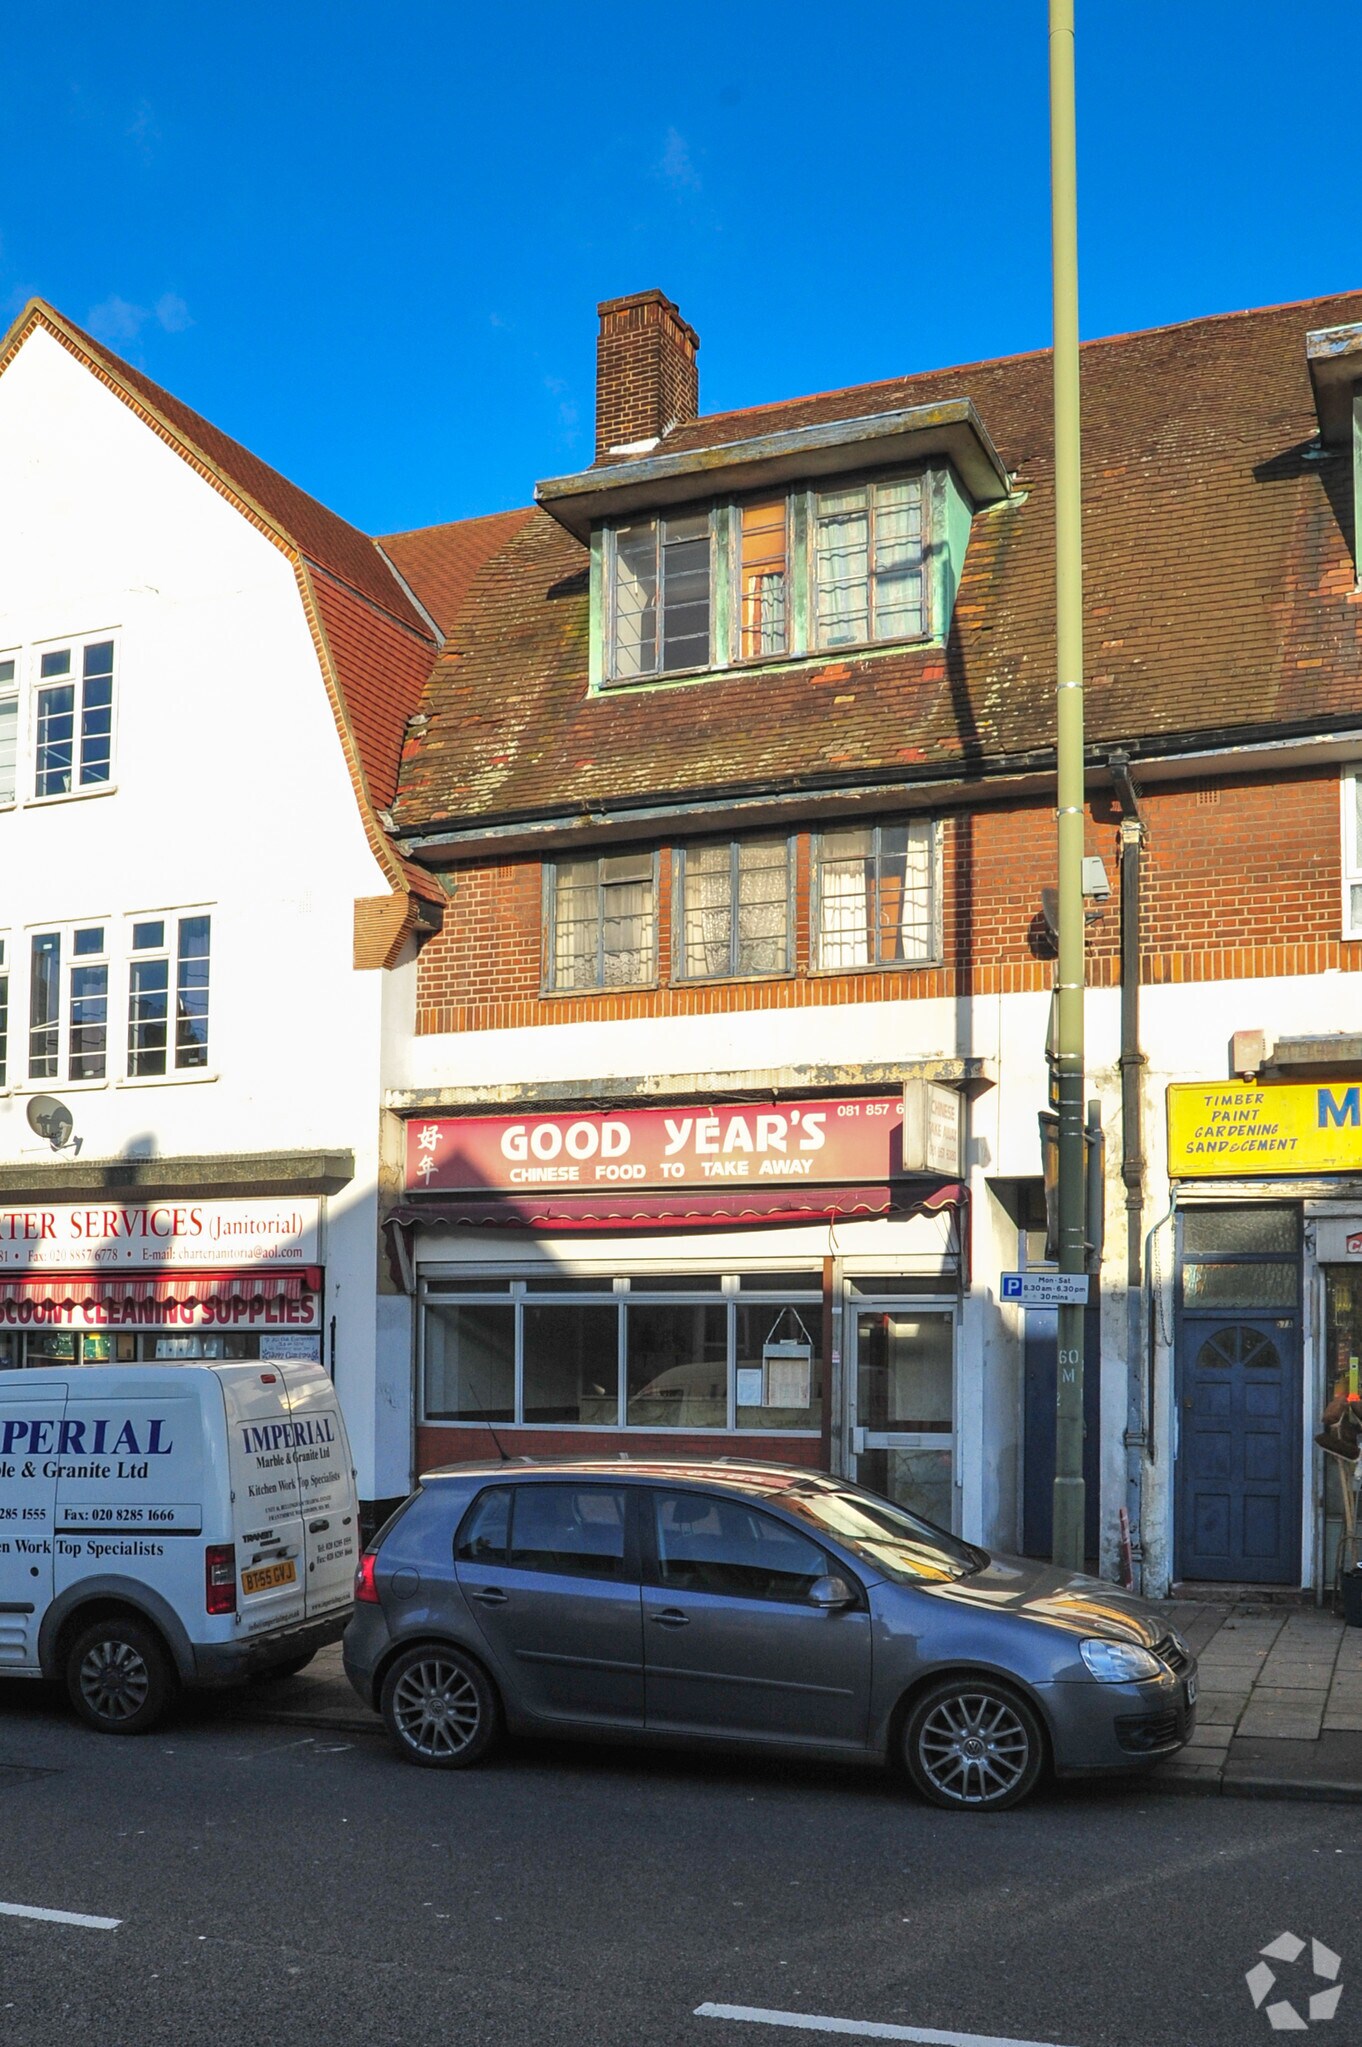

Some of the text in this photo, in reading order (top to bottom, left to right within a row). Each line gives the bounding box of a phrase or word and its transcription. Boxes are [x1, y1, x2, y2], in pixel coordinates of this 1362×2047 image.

[1204, 1093, 1265, 1107] TIMBER
[1317, 1087, 1361, 1128] M
[837, 1104, 860, 1117] 081
[865, 1103, 890, 1116] 857
[1211, 1109, 1260, 1123] PAINT
[500, 1110, 827, 1161] GOOD YEAR'S
[1195, 1124, 1279, 1138] GARDENING
[509, 1159, 814, 1183] CHINESE FOOD TO TAKE AWAY
[70, 1208, 203, 1239] SERVICES
[209, 1212, 303, 1241] (Janitorial)
[28, 1249, 47, 1262] Fax:
[50, 1250, 67, 1262] 020
[94, 1248, 118, 1261] 6778
[142, 1246, 176, 1261] E-mail:
[1007, 1279, 1020, 1295] P
[0, 1295, 315, 1325] COUNT CLEANING SUPPLIES
[1059, 1349, 1079, 1364] 60
[1062, 1368, 1075, 1383] M
[0, 1419, 174, 1455] PERIAL
[241, 1418, 335, 1455] IMPERIAL
[256, 1453, 285, 1470] Marble
[293, 1447, 319, 1464] Granite
[319, 1446, 331, 1460] Ltd
[0, 1461, 149, 1479] le & Granite Ltd
[248, 1482, 278, 1498] Kitchen
[278, 1477, 297, 1492] Work
[310, 1471, 341, 1488] Specialists
[0, 1508, 175, 1521] 285 1555 Fax: 020 8285 1666
[242, 1529, 274, 1544] TRANSIT
[15, 1539, 52, 1554] Work
[56, 1540, 82, 1558] Top
[86, 1540, 164, 1558] Specialists
